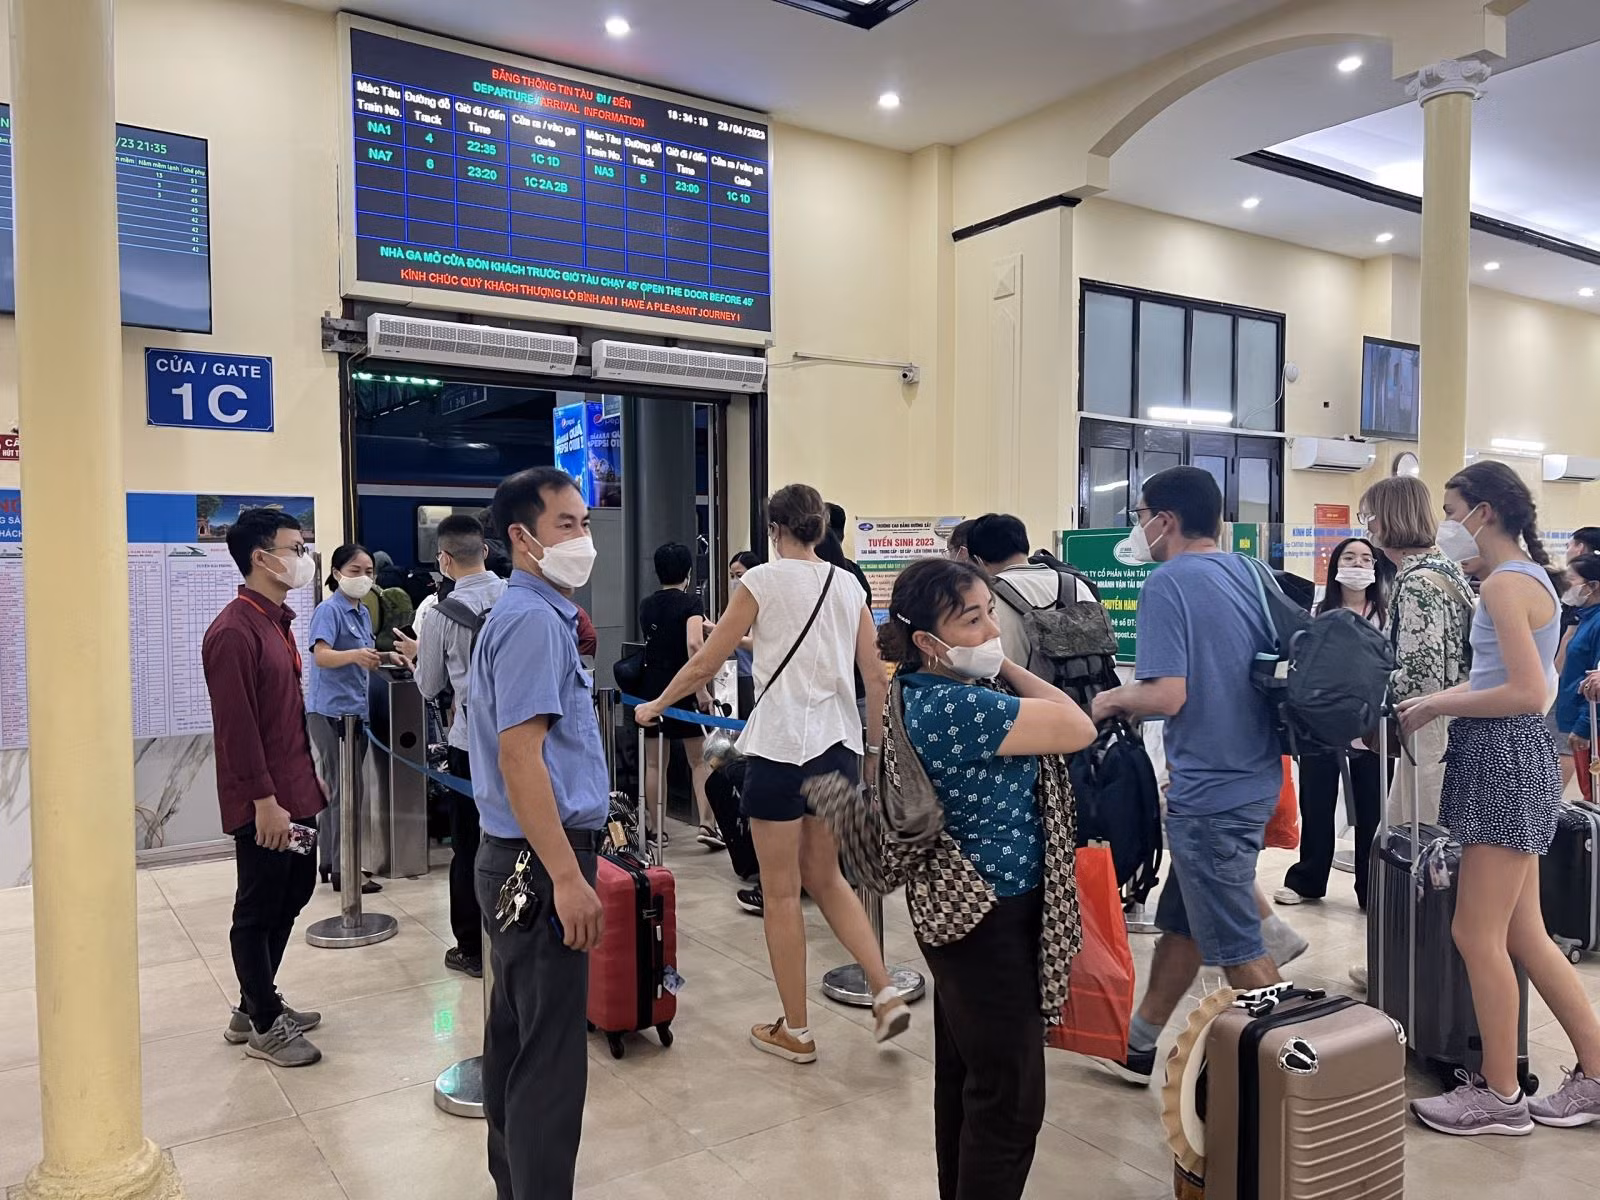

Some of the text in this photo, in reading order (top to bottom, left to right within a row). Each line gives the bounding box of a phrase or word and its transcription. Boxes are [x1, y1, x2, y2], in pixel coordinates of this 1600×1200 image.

[521, 76, 556, 91] THÔNG
[557, 84, 572, 96] TIN
[574, 87, 593, 100] TÀU
[596, 92, 606, 104] ĐI
[612, 96, 632, 109] ĐẾN
[356, 98, 402, 118] Train No.
[473, 82, 534, 104] DEPARTURE
[541, 98, 580, 114] ARRIVAL
[584, 106, 645, 127] INFORMATION
[413, 110, 442, 125] Track
[367, 121, 391, 136] NA1
[468, 121, 491, 135] Time
[425, 132, 434, 144] 4
[137, 140, 167, 154] 21:35
[467, 141, 497, 155] 22:35
[368, 147, 393, 162] NA7
[531, 153, 560, 167] 1C 1D
[467, 166, 497, 180] 23:20
[594, 165, 615, 178] NA3
[676, 163, 695, 176] Time
[524, 176, 568, 193] 1C 2A 2B
[640, 174, 647, 184] 5
[675, 180, 700, 194] 23:00
[726, 191, 751, 204] 1C 1D
[380, 246, 404, 259] NHÀ
[405, 250, 422, 262] GA
[466, 257, 490, 271] ĐÓN
[491, 261, 525, 276] KHÁCH
[526, 266, 561, 280] TRƯỚC
[580, 273, 599, 285] TÀU
[600, 277, 625, 290] CHẠY
[640, 282, 665, 295] OPEN
[665, 285, 683, 297] THE
[684, 288, 708, 301] DOOR
[709, 292, 742, 305] BEFORE
[400, 268, 426, 282] KÍNH
[428, 273, 459, 286] CHÚC
[460, 276, 483, 289] QUÝ
[484, 279, 518, 294] KHÁCH
[520, 284, 562, 299] THƯỢNG
[563, 290, 576, 302] LỘ
[577, 290, 599, 304] BÌNH
[600, 296, 613, 305] AN
[621, 298, 645, 310] HAVE
[646, 301, 653, 311] A
[654, 302, 698, 316] PLEASANT
[698, 308, 736, 321] JOURNEY
[156, 355, 262, 379] CỬA / GATE
[894, 538, 914, 547] SINH
[915, 537, 935, 547] 2023
